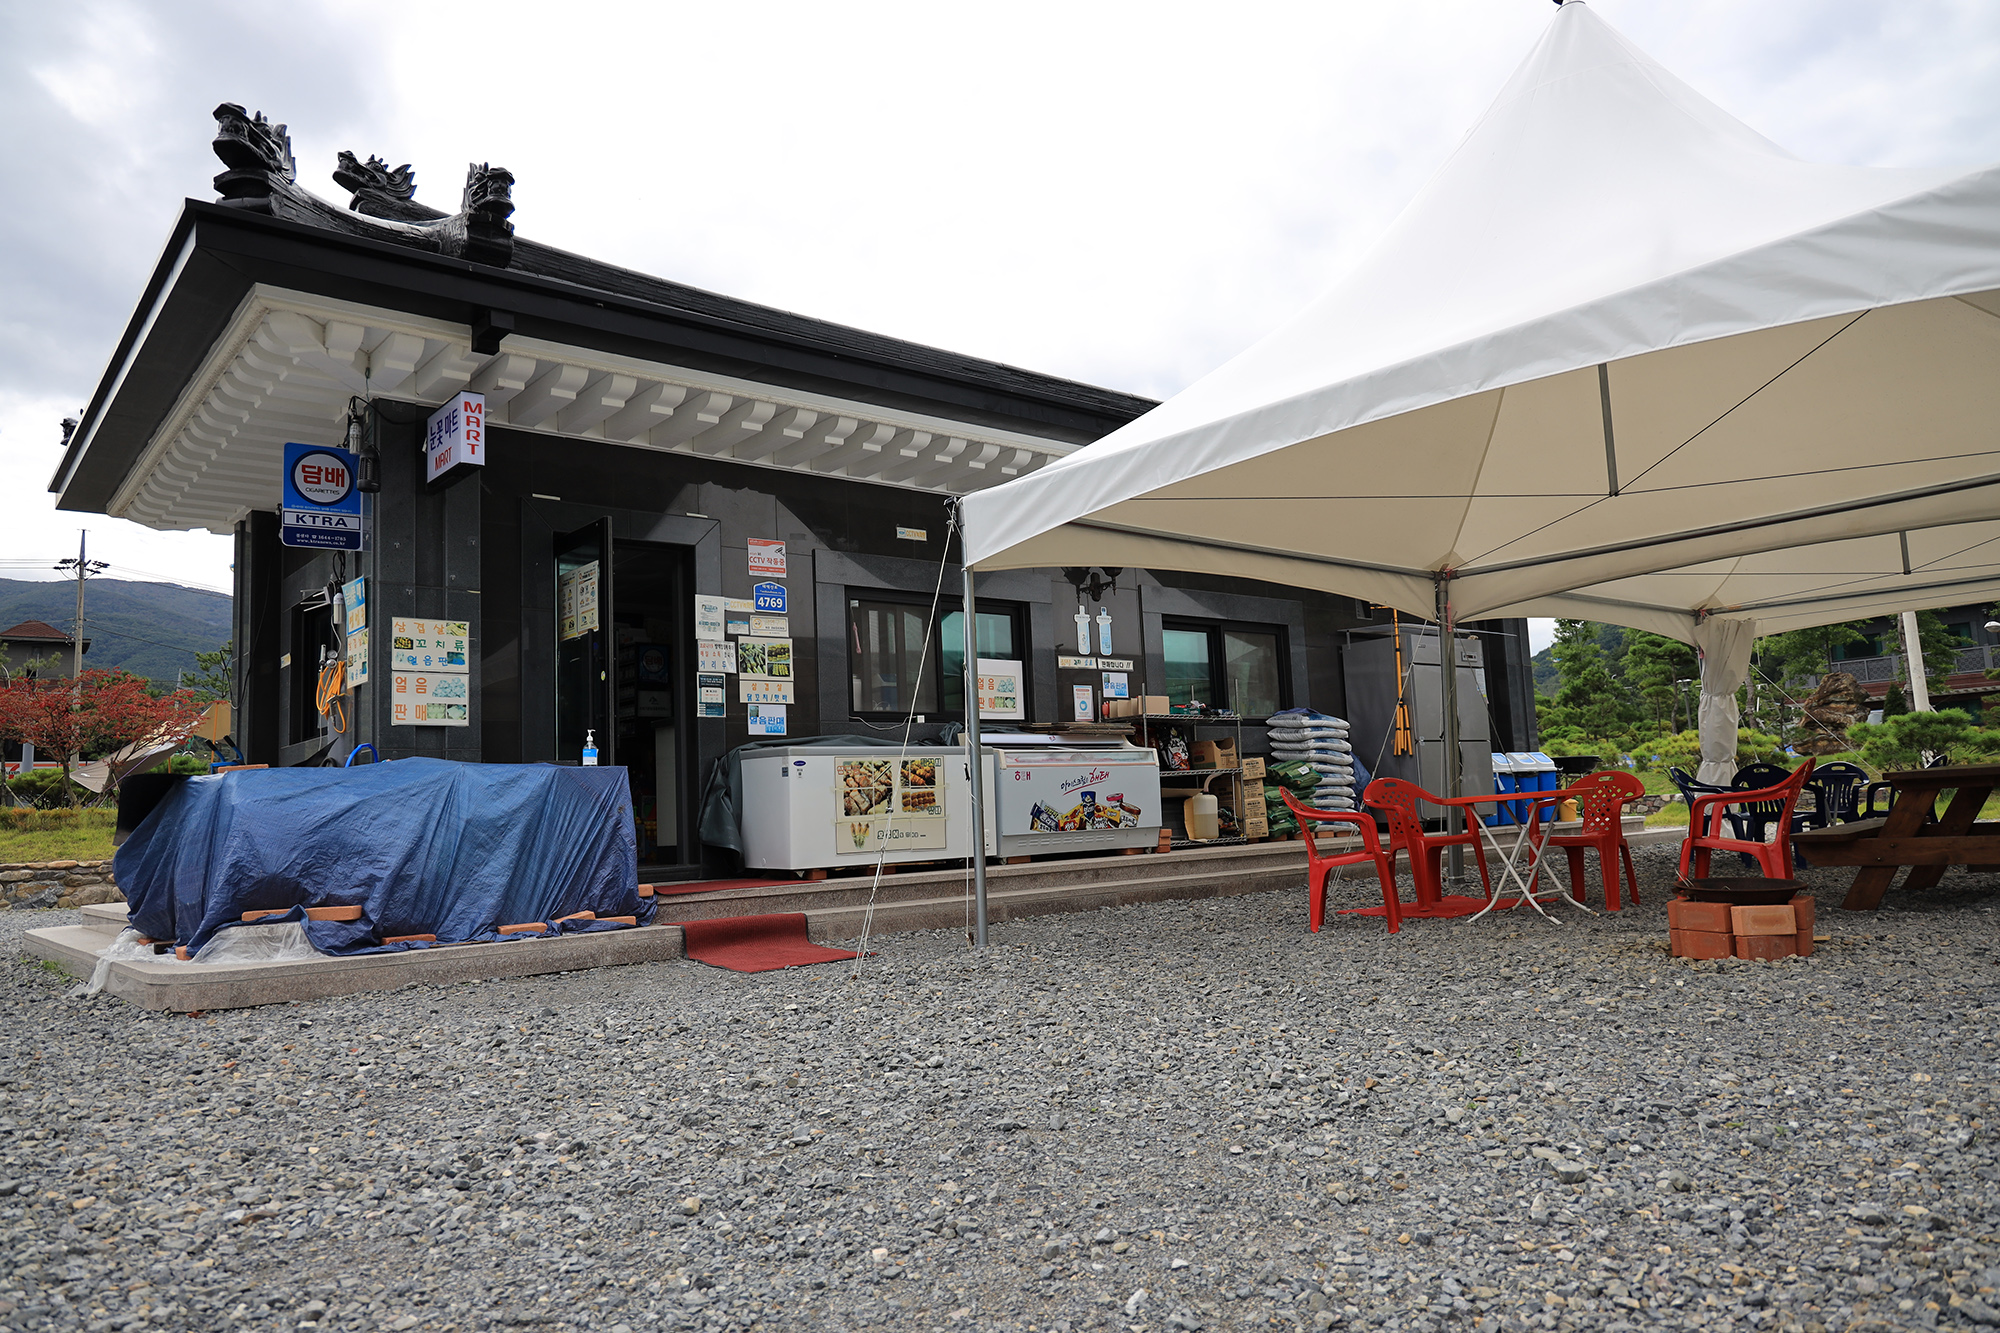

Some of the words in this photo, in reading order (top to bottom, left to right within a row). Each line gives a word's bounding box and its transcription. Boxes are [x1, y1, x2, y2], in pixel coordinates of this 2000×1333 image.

[464, 401, 482, 455] MART
[434, 446, 452, 472] MART
[301, 464, 345, 488] 담배
[295, 513, 348, 528] KTRA
[749, 555, 766, 564] CCTV
[757, 596, 783, 609] 4769
